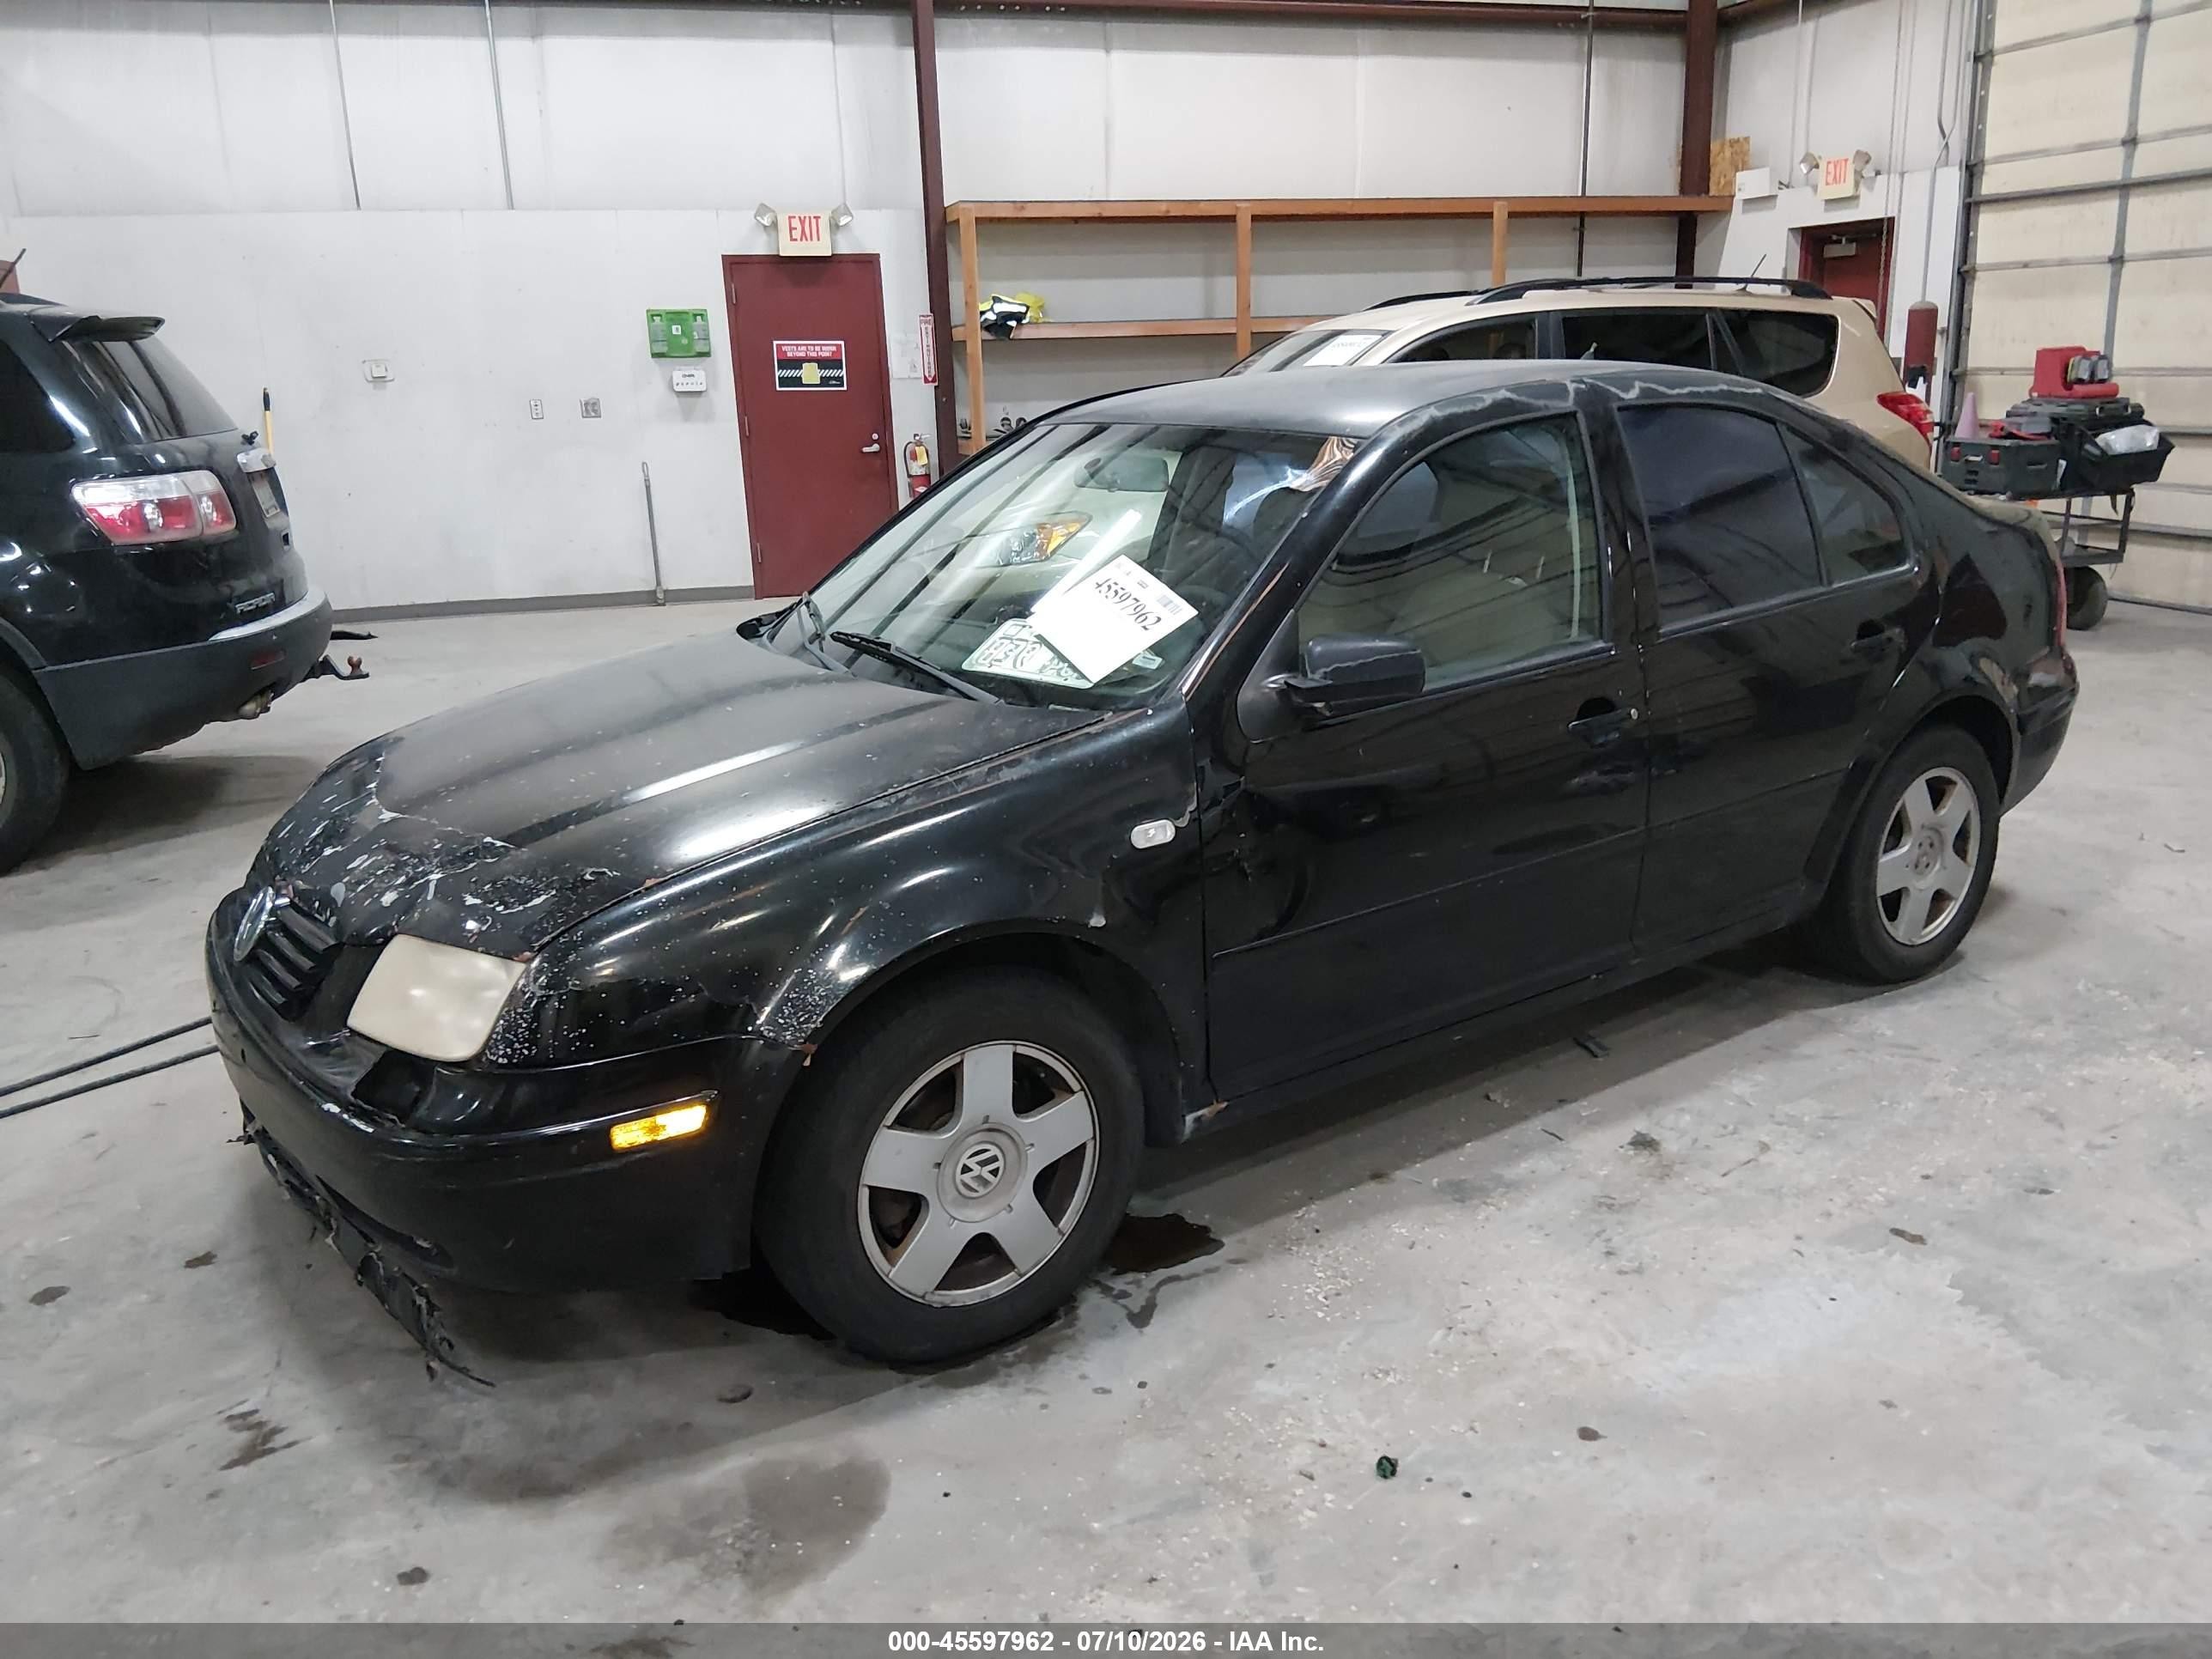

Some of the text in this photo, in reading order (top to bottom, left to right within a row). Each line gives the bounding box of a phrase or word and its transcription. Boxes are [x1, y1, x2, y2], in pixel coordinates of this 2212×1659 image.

[1826, 159, 1849, 185] EXIT
[787, 215, 821, 241] EXIT
[1095, 578, 1162, 630] 45597962
